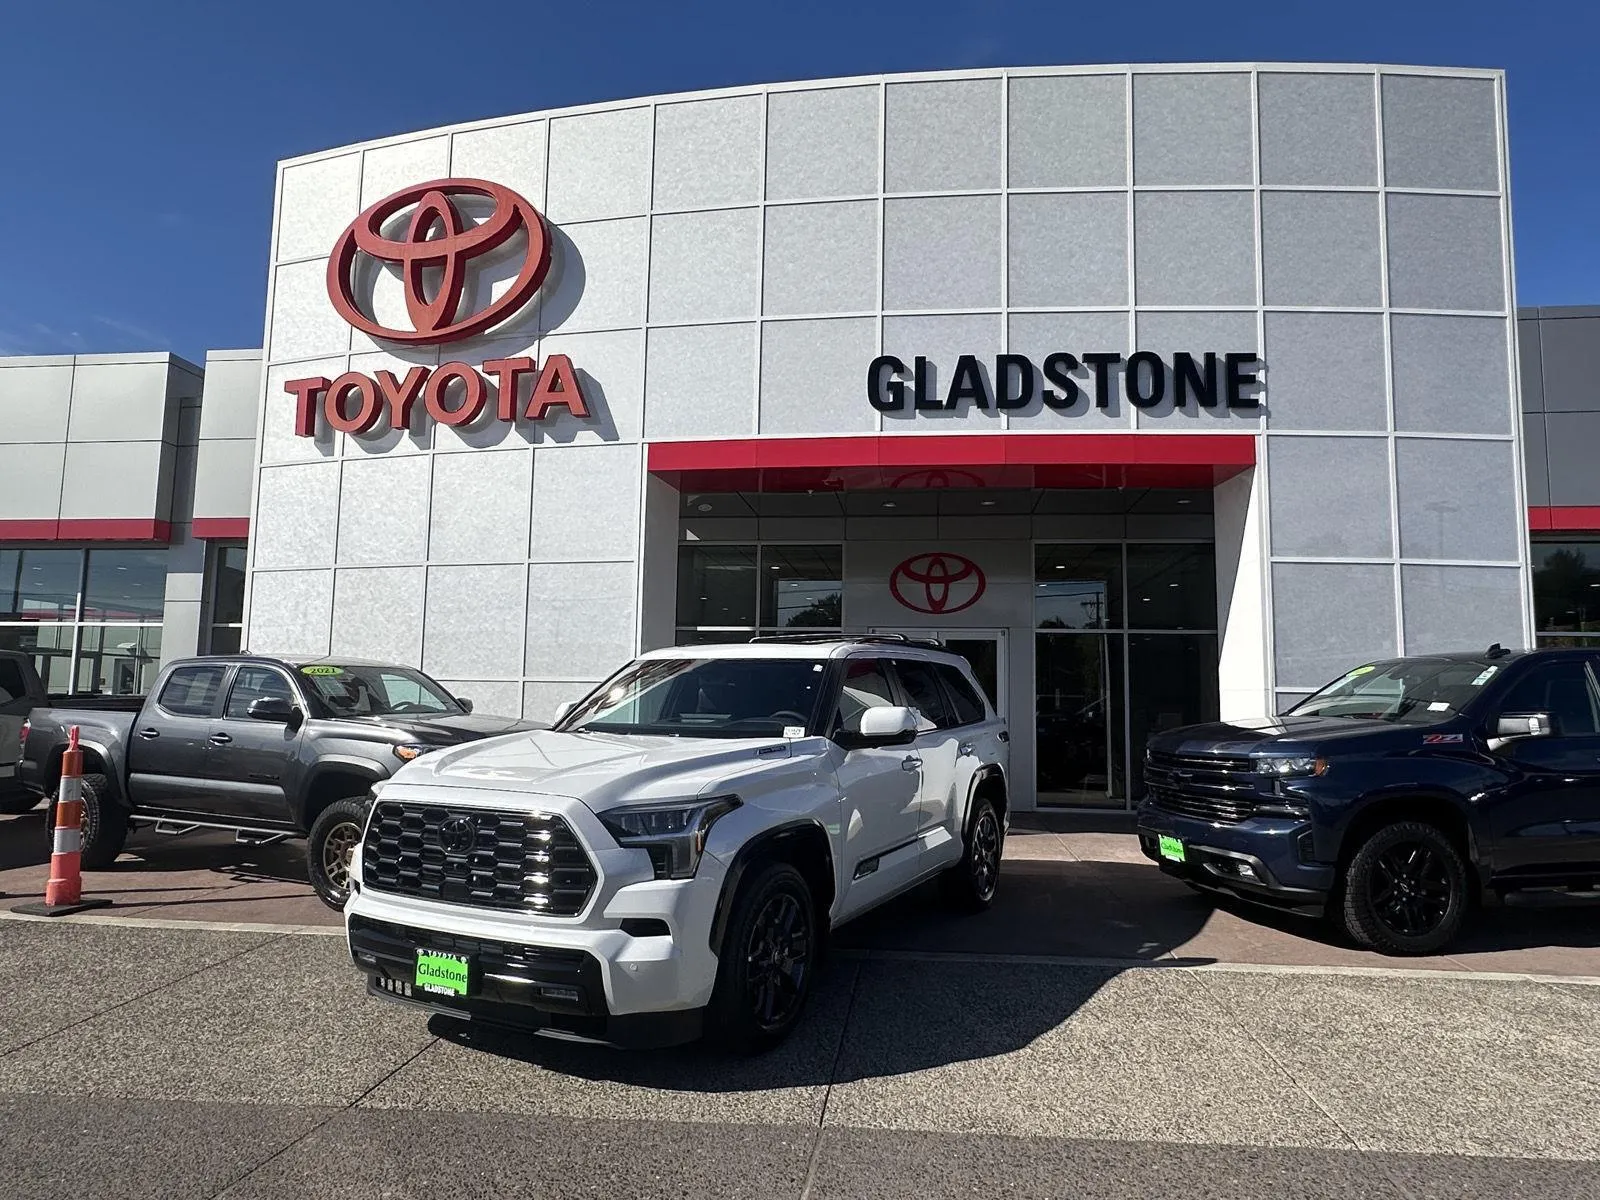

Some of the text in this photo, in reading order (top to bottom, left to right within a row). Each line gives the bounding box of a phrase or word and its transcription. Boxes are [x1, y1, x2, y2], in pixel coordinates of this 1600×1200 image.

[867, 350, 1261, 411] GLADSTONE
[284, 354, 590, 437] TOYOTA
[428, 950, 457, 960] TOYOTA
[418, 963, 467, 983] Gladstone
[424, 983, 455, 996] GLADSTONE
